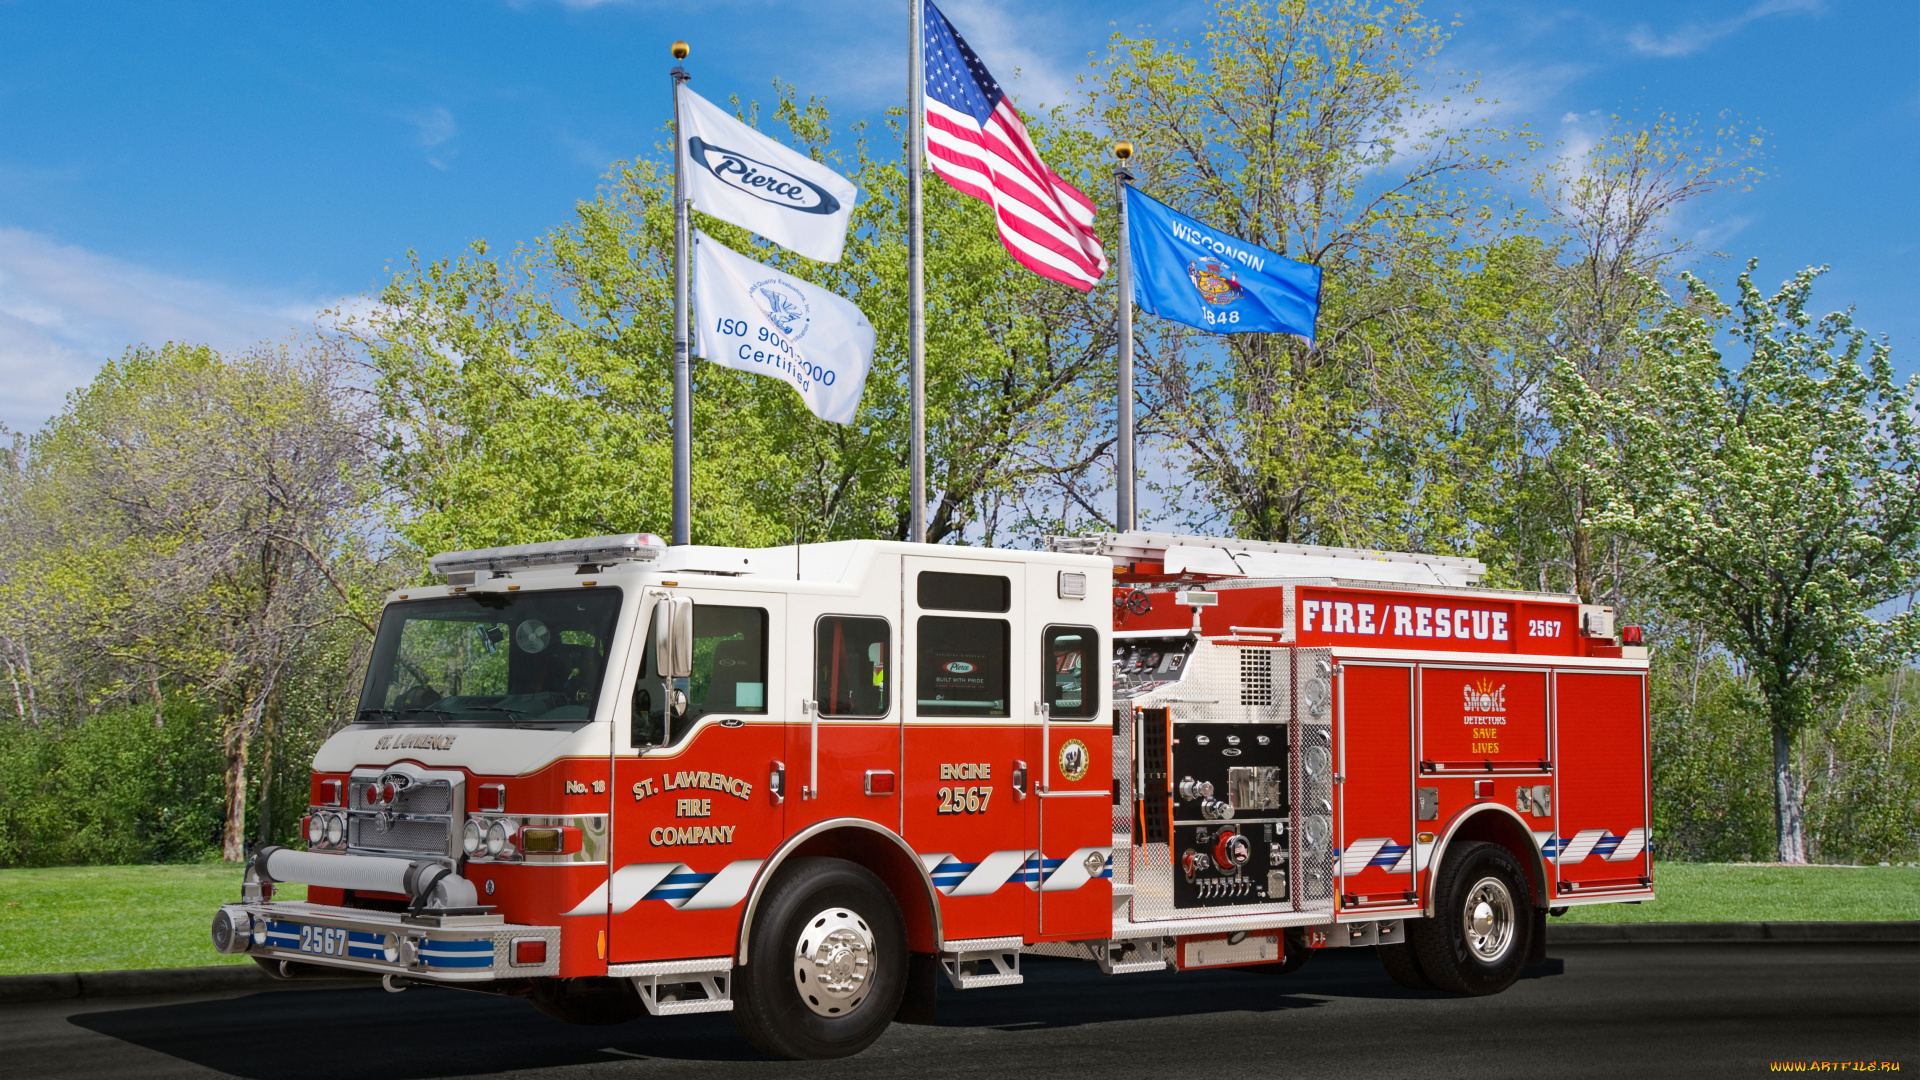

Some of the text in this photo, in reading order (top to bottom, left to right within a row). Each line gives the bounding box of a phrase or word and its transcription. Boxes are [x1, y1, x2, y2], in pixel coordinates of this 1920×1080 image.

[714, 155, 804, 200] Pierce
[1172, 220, 1265, 272] WISCONSIN
[757, 279, 776, 287] Quality
[1202, 306, 1240, 325] 1848
[716, 317, 836, 387] ISO 9001:2000
[738, 344, 810, 392] Certified
[1302, 599, 1562, 641] FIRE/RESCUE 2567
[950, 662, 970, 671] Pierce
[1463, 684, 1507, 712] SMOKE
[1463, 716, 1507, 725] DETECTORS
[391, 732, 459, 751] LAWRENCE
[1473, 728, 1497, 739] SAVE
[1472, 742, 1500, 754] LIVES
[940, 763, 991, 780] ENGINE
[565, 780, 606, 795] No. 18
[632, 771, 753, 801] ST. LAWRENCE
[676, 799, 711, 818] FIRE
[937, 786, 994, 815] 2567
[649, 825, 737, 847] COMPANY
[301, 924, 347, 957] 2567
